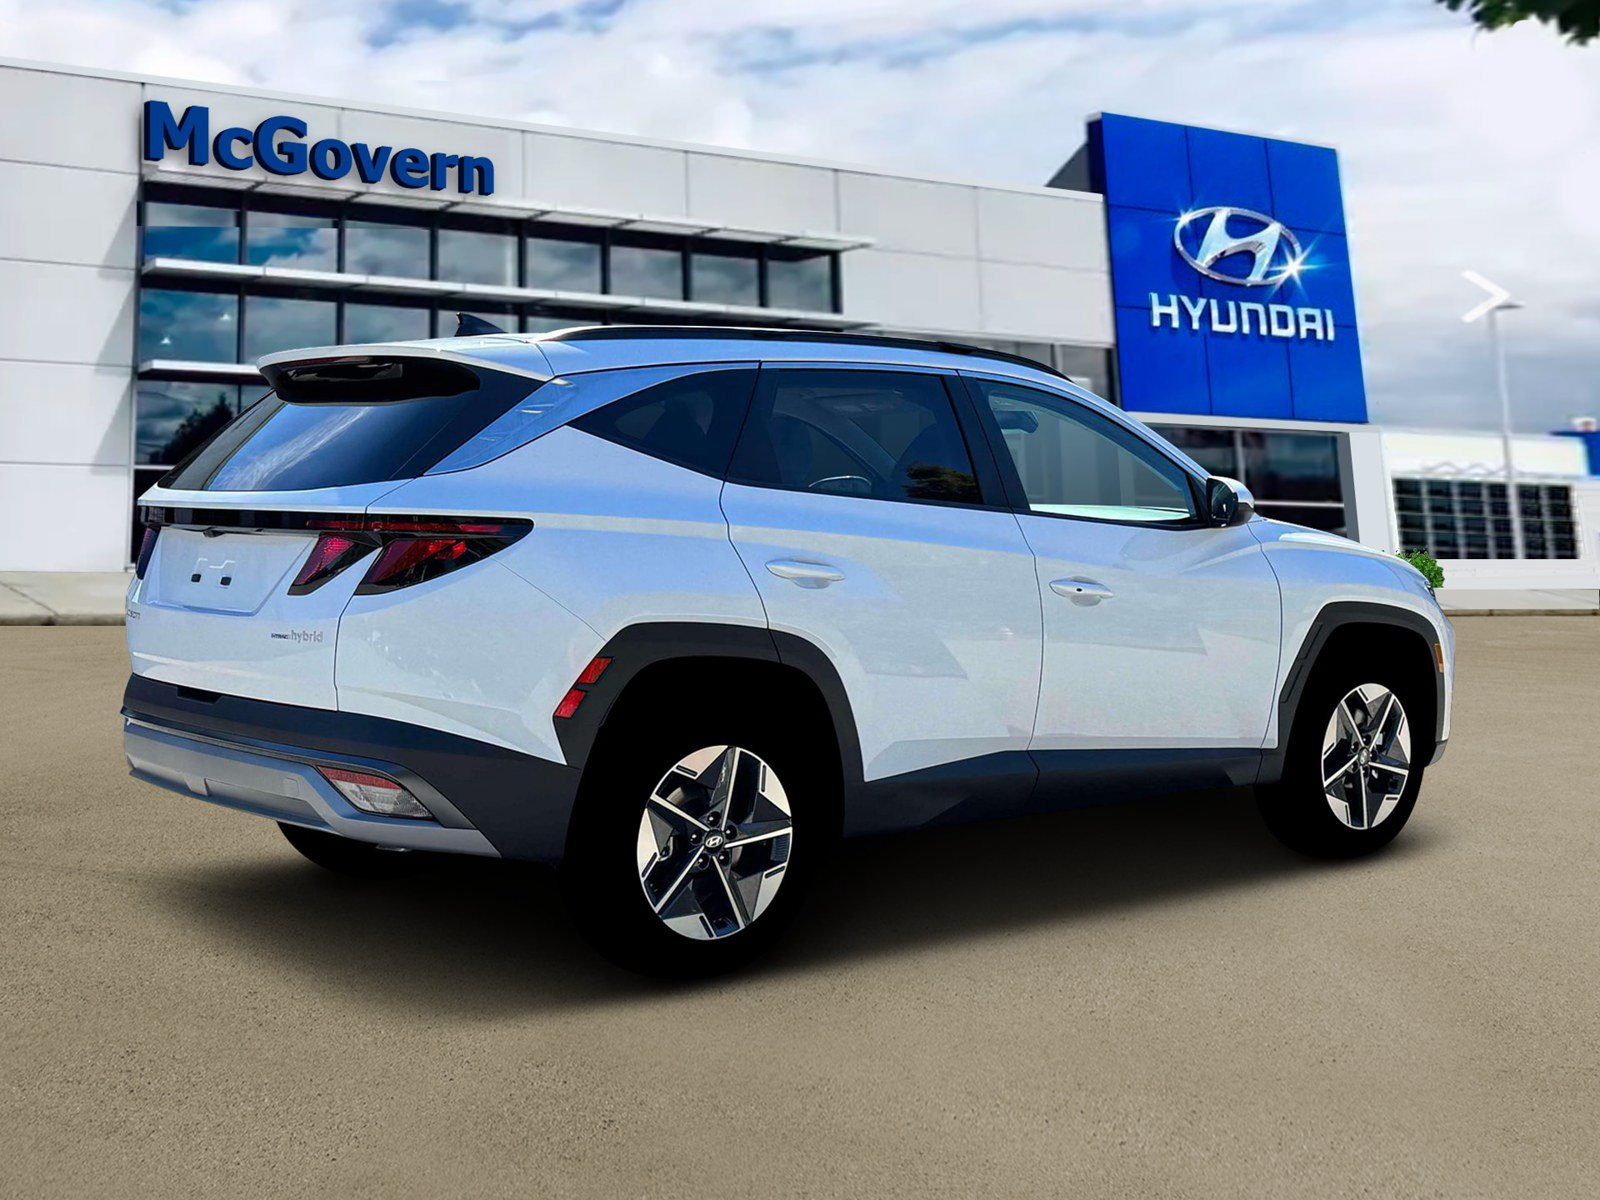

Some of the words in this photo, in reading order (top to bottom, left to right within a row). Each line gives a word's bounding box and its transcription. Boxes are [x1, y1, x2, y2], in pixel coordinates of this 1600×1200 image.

[143, 100, 495, 195] McGovern
[1150, 292, 1335, 341] HYUNDAI
[291, 629, 323, 643] hybrid
